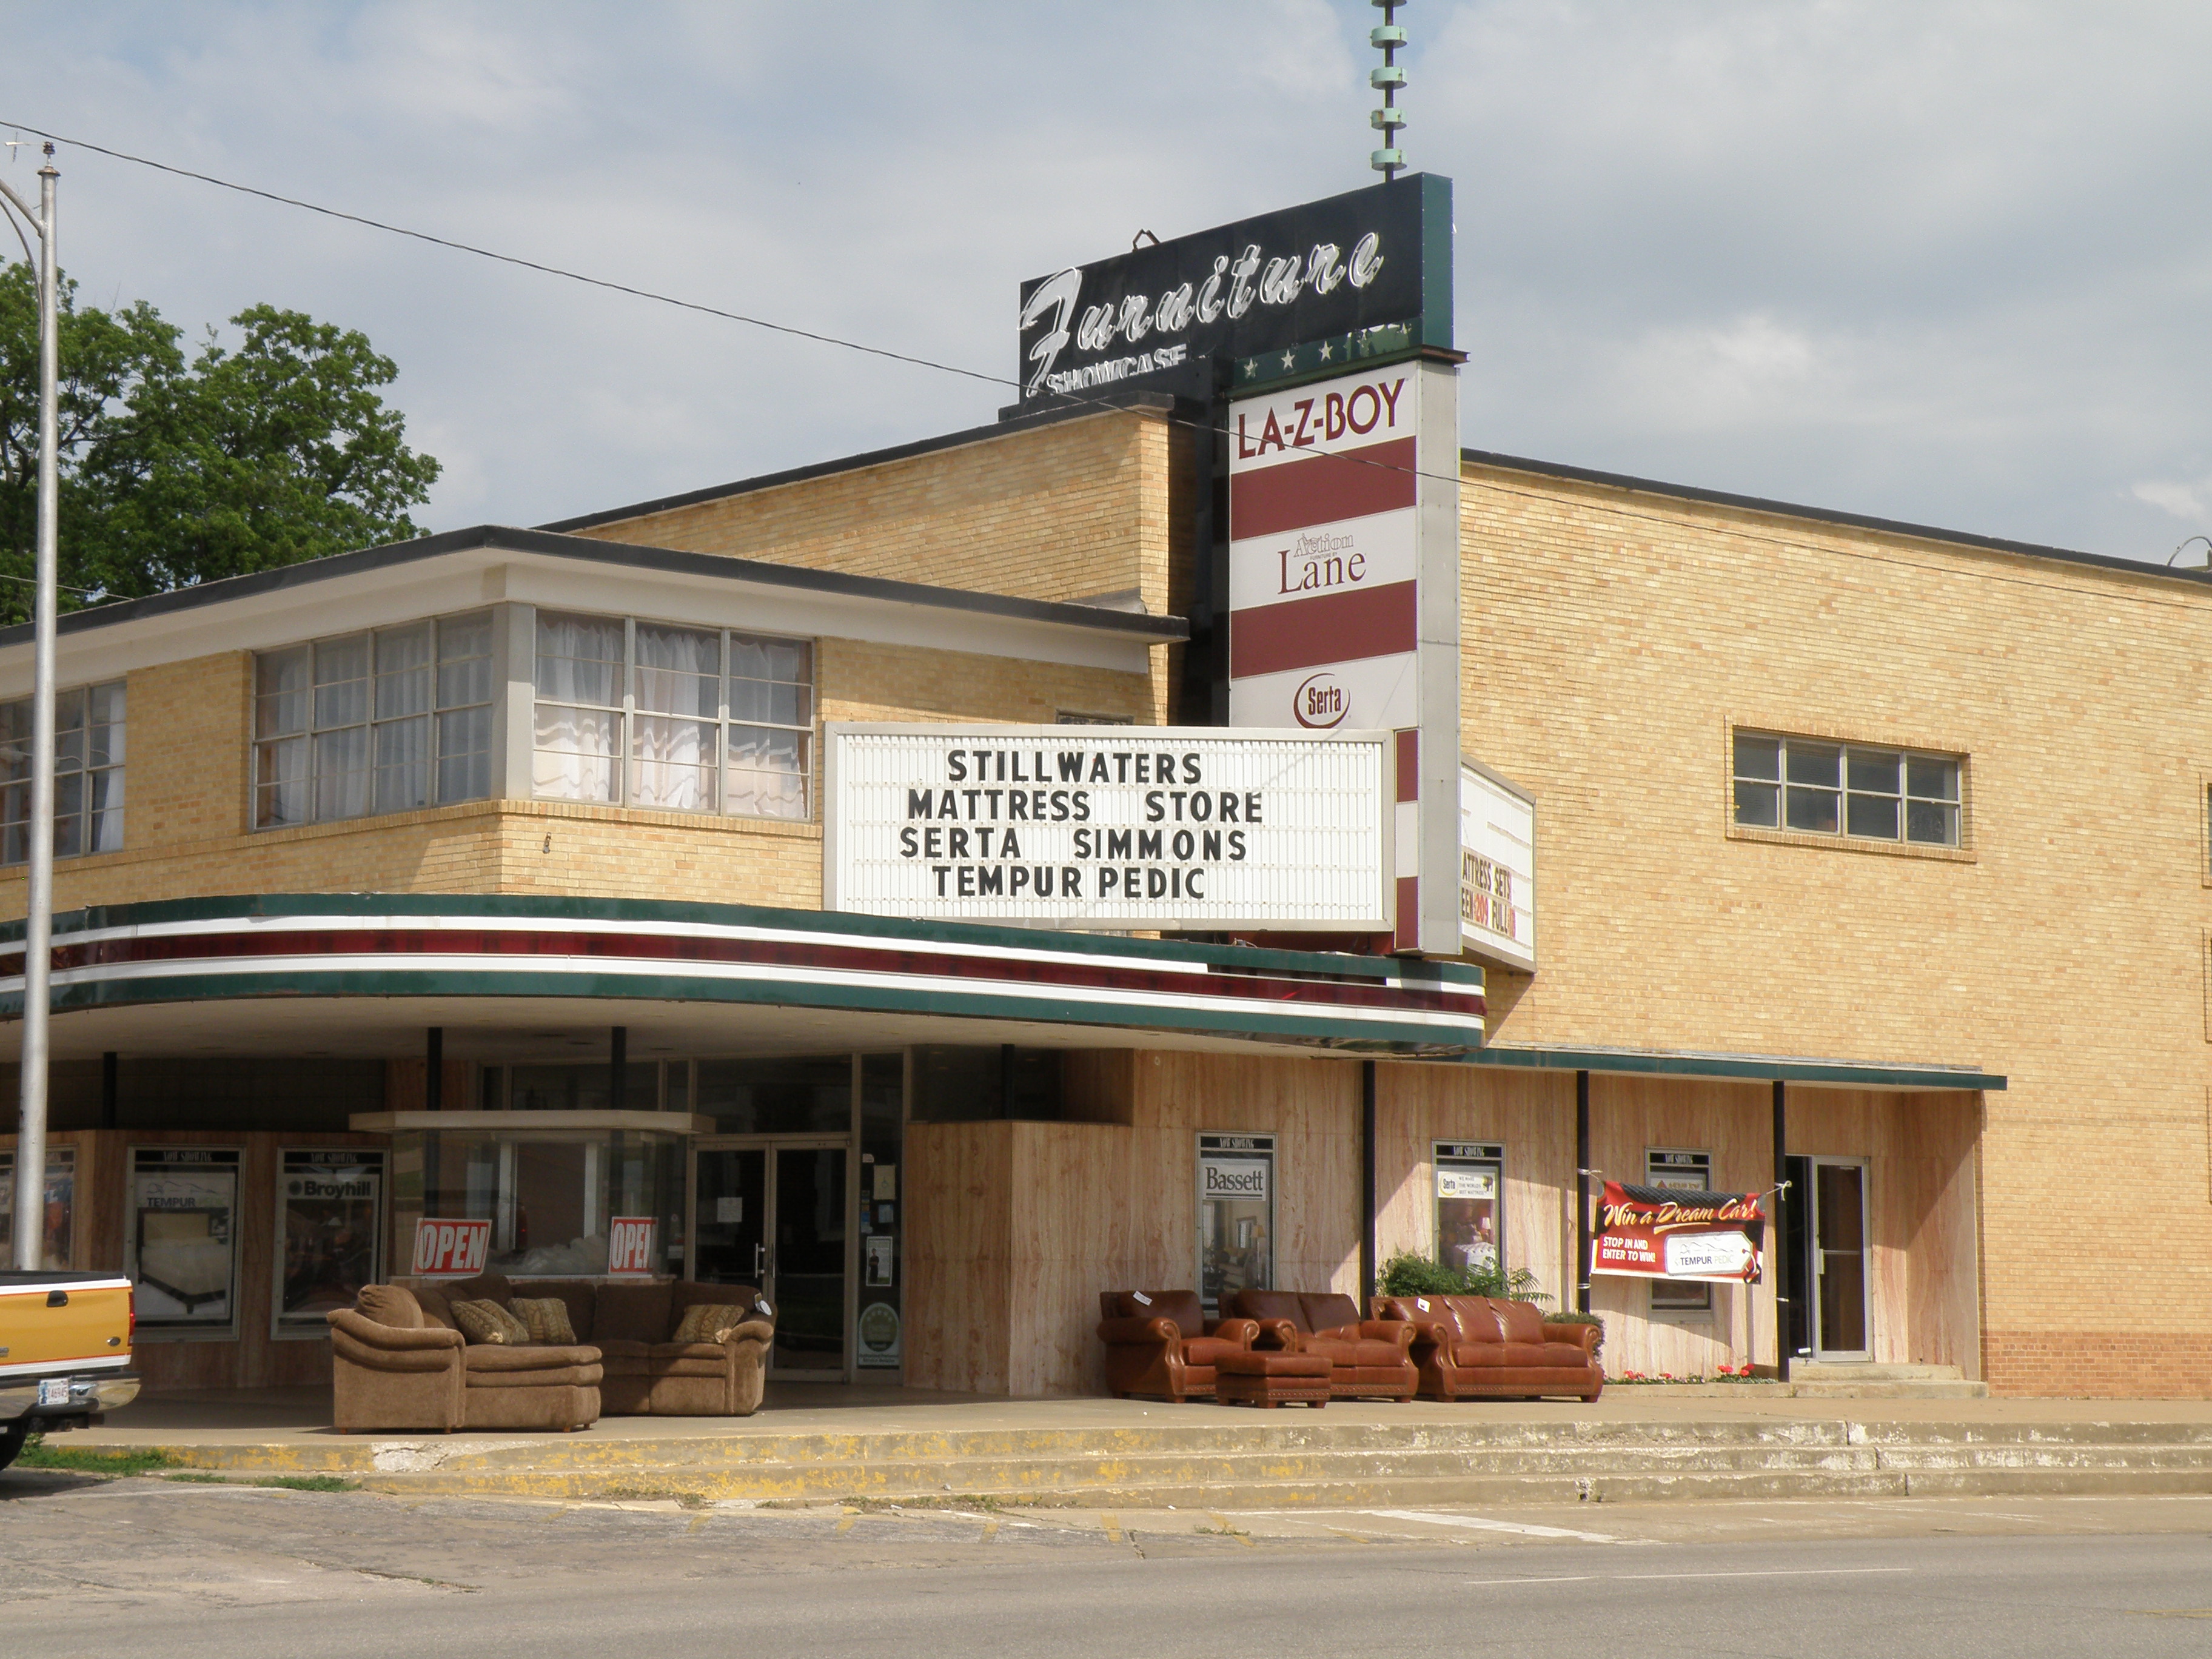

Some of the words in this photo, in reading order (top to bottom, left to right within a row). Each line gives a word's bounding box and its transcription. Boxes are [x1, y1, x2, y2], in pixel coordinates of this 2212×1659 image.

[1018, 232, 1384, 398] Furniture
[1238, 378, 1405, 460] LA-Z-BOY
[1293, 532, 1354, 558] Action
[1277, 549, 1367, 595] Lane
[1308, 686, 1341, 716] Serta
[948, 750, 1202, 785] STILLWATERS
[908, 789, 1090, 822] MATTRESS
[1146, 791, 1262, 823] STORE
[901, 827, 1021, 859] SERTA
[1074, 828, 1247, 860] SIMMONS
[932, 865, 1082, 897] TEMPUR
[1099, 867, 1204, 899] PEDIC
[304, 1180, 370, 1199] Broyhill
[1205, 1166, 1264, 1191] Bassett
[1443, 1178, 1456, 1190] Serta
[146, 1197, 196, 1208] TEMPUR
[1603, 1202, 1637, 1227] Win
[1640, 1212, 1653, 1225] a
[1655, 1201, 1714, 1224] Dream
[1718, 1198, 1757, 1221] Car!
[417, 1224, 486, 1270] OPEN
[1603, 1236, 1624, 1248] STOP
[1624, 1238, 1633, 1249] IN
[1634, 1239, 1649, 1250] AND
[1603, 1248, 1626, 1260] ENTER
[1627, 1250, 1638, 1261] TO
[1639, 1251, 1656, 1263] WIN!
[1680, 1256, 1712, 1266] TEMPUR
